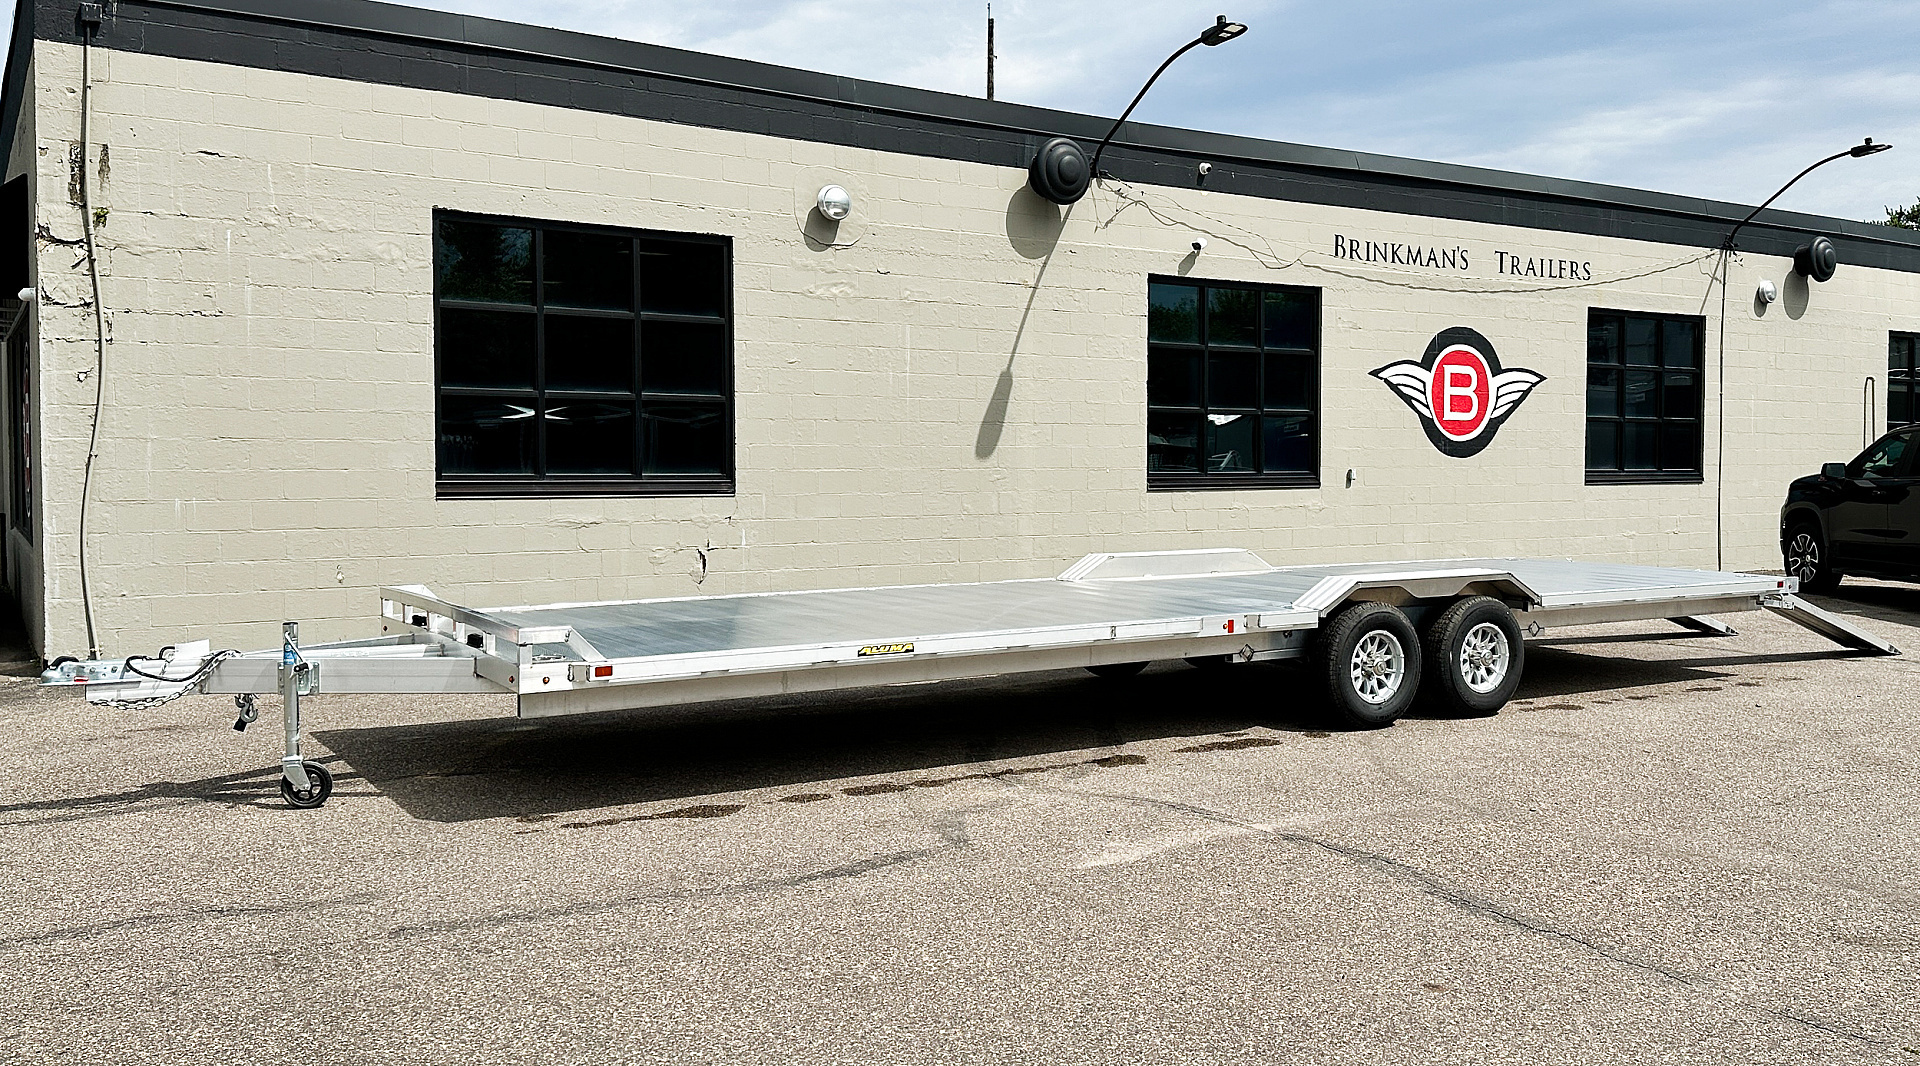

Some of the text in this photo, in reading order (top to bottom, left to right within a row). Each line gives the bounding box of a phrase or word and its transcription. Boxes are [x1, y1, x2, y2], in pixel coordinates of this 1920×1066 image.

[1334, 234, 1591, 280] BRINKMAN'S TRAILERS
[1443, 365, 1479, 421] B
[858, 643, 914, 657] ALUMA
